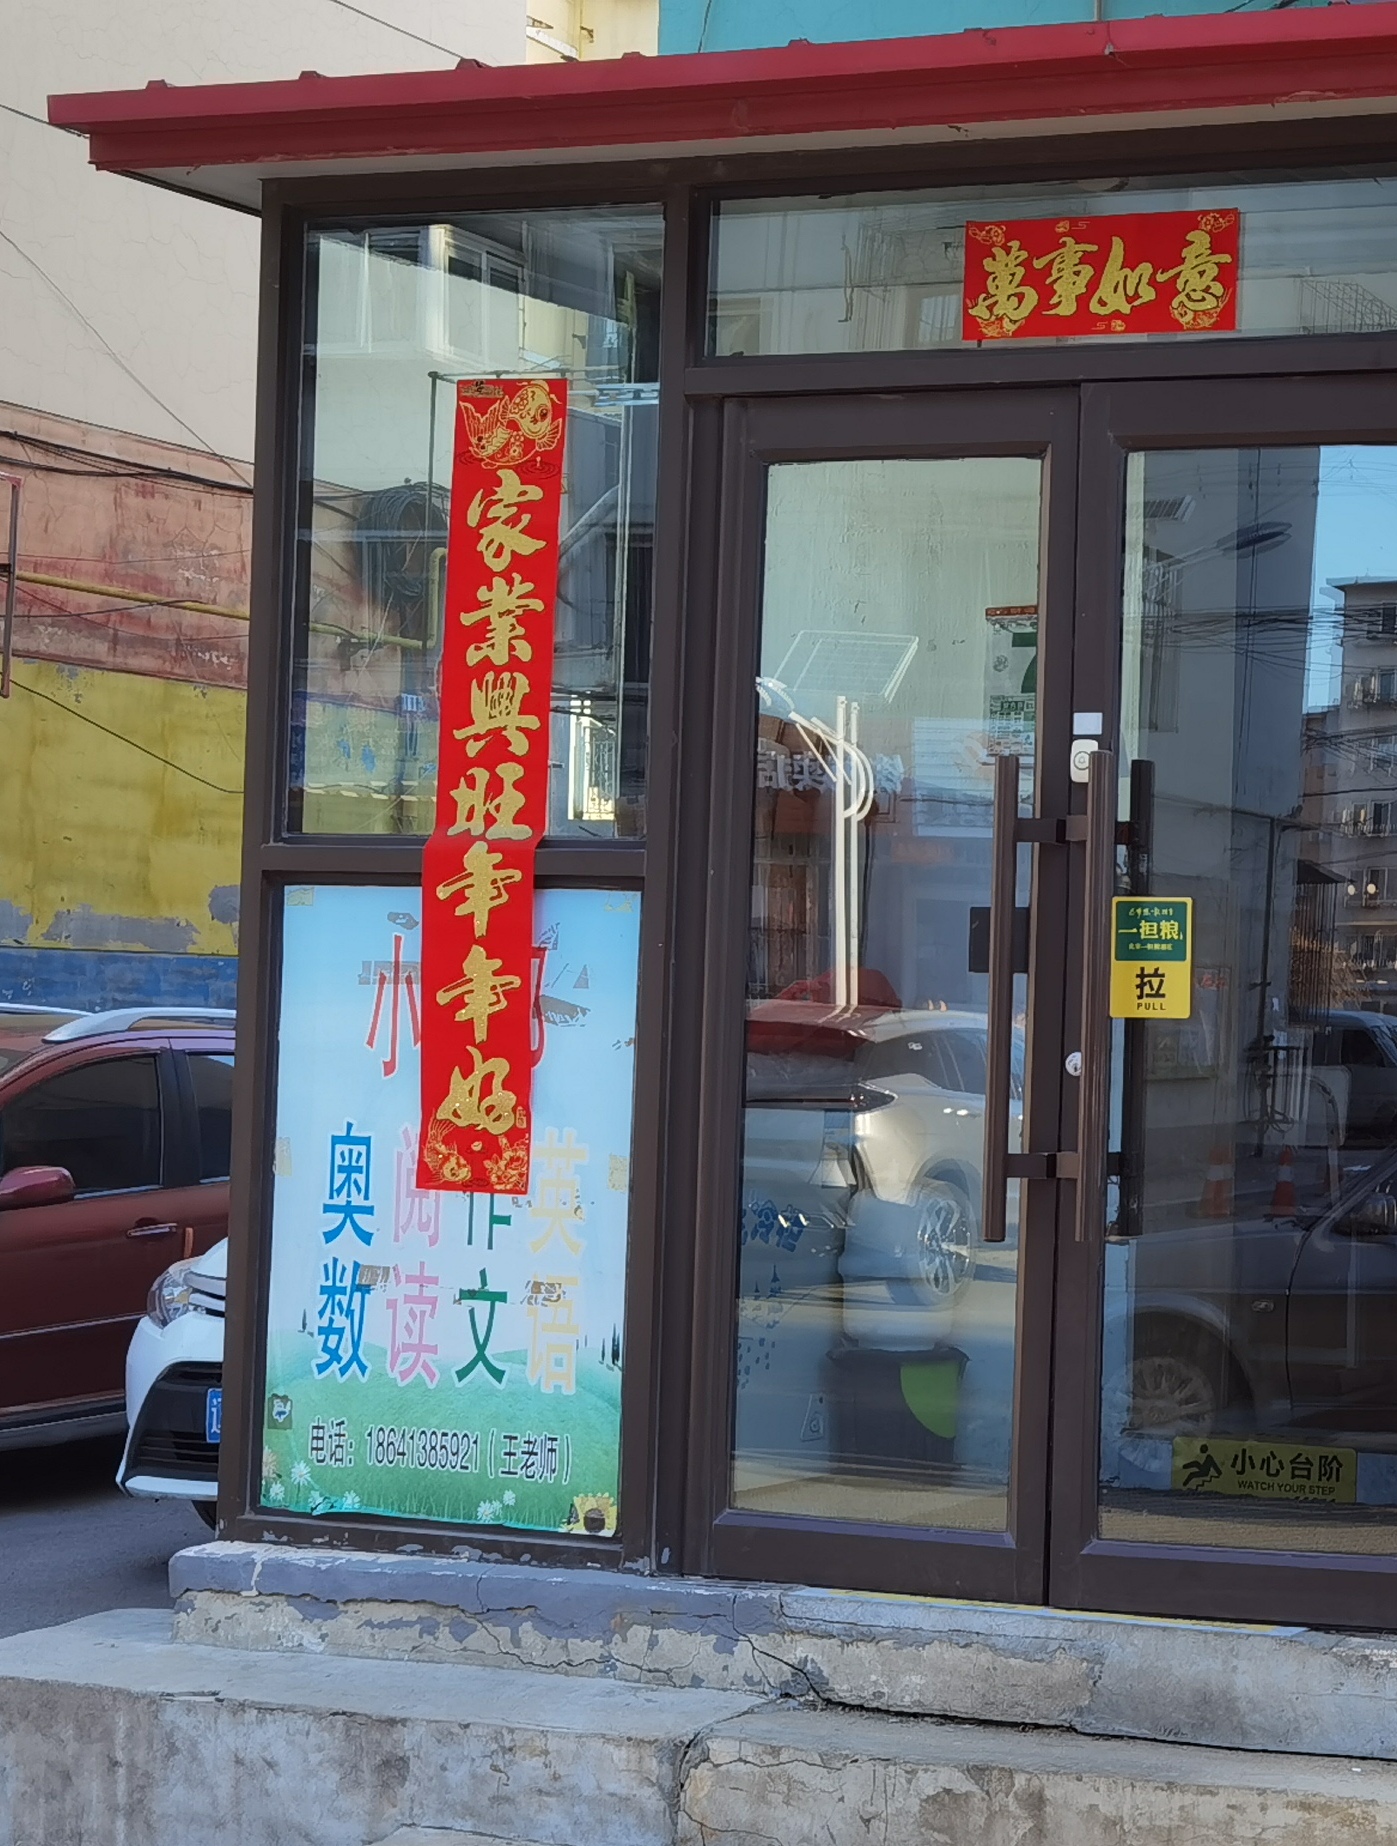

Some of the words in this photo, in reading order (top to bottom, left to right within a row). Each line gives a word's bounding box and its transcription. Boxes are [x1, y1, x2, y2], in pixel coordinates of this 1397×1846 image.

[1117, 919, 1179, 940] 一担粮
[1135, 966, 1166, 1000] 拉
[1136, 1002, 1166, 1011] PULL
[316, 1121, 376, 1379] 奥数
[526, 1126, 589, 1393] 英语
[1230, 1448, 1343, 1482] 小心台阶
[1237, 1479, 1275, 1492] WATCH
[1277, 1482, 1307, 1494] YOUR
[1308, 1484, 1336, 1496] STEP
